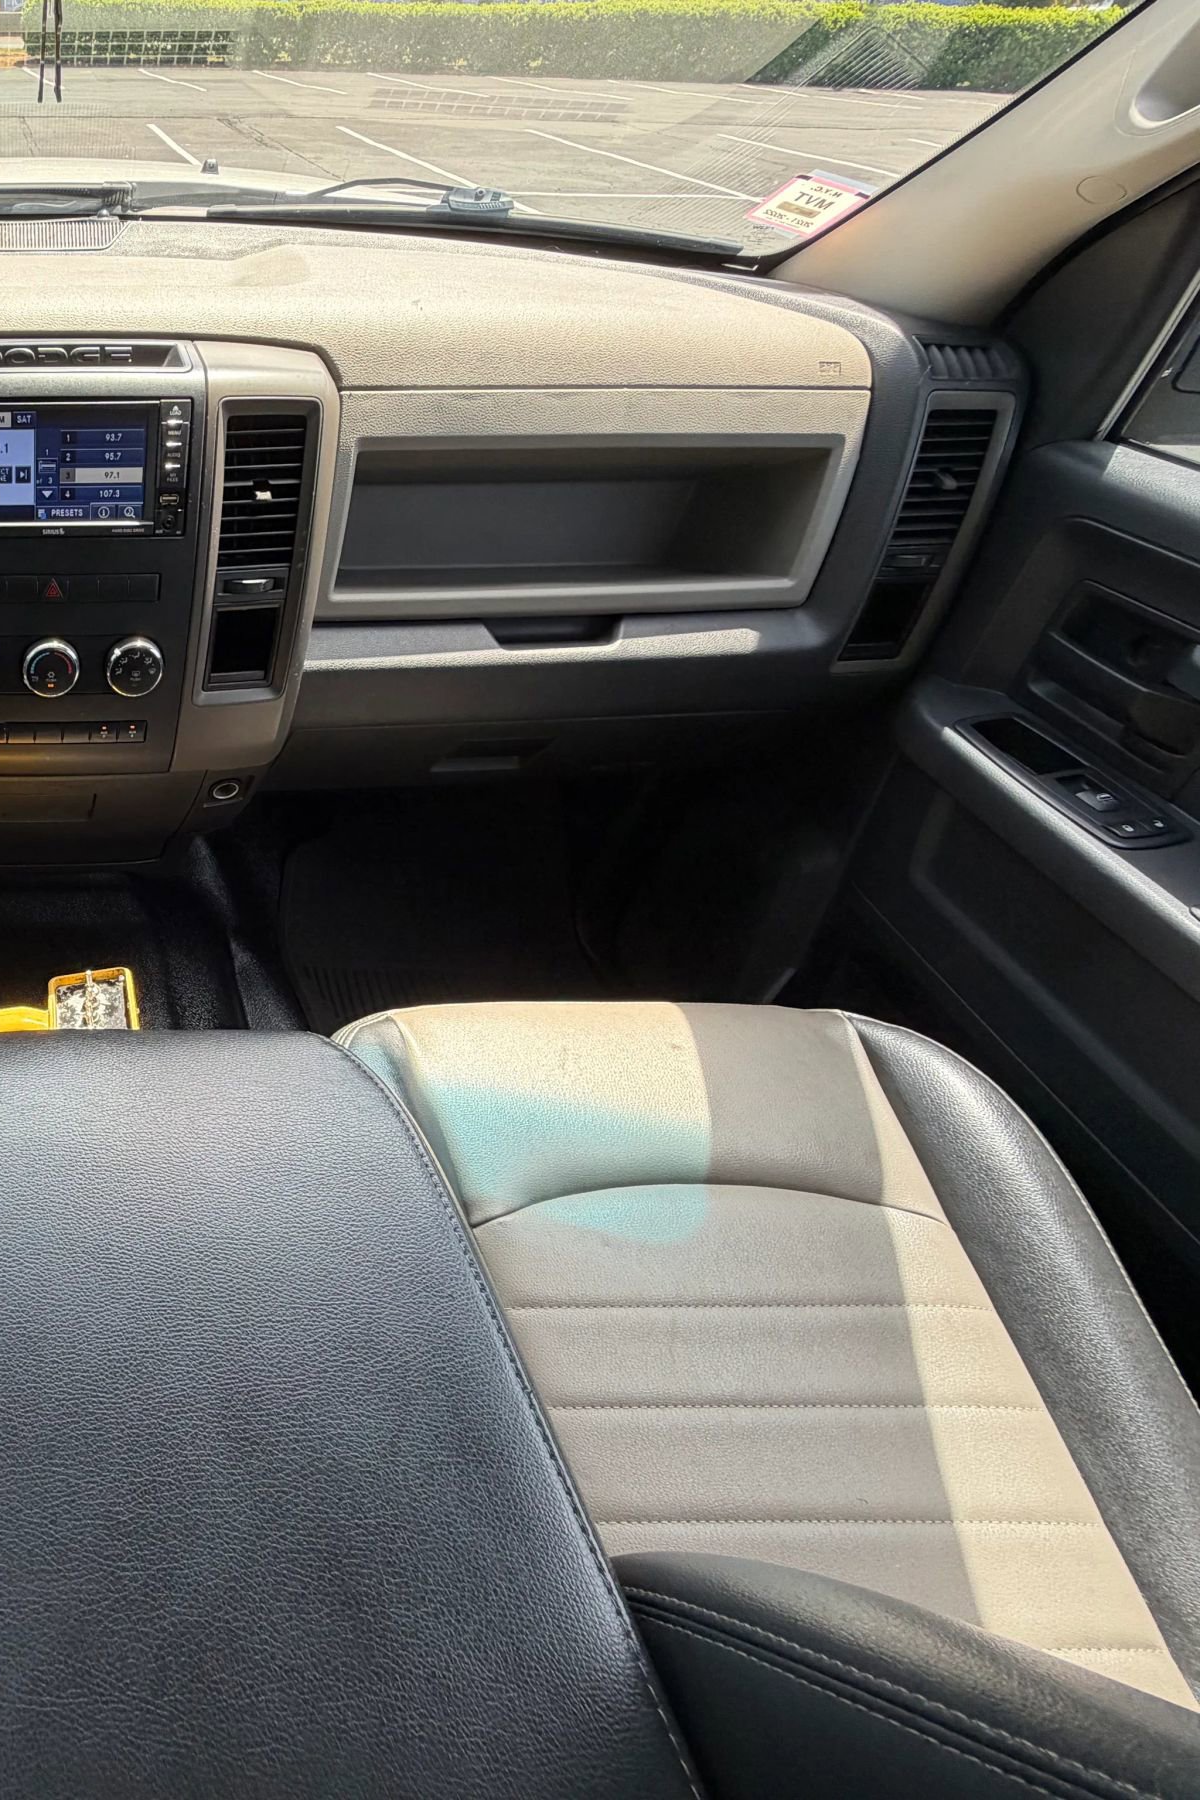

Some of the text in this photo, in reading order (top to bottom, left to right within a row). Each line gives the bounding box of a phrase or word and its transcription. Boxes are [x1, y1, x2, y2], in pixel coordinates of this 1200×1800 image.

[17, 415, 31, 423] SAT
[67, 433, 122, 442] 1 93.7
[66, 453, 71, 461] 2
[65, 490, 120, 498] 4 107.3
[51, 509, 83, 517] PRESETS
